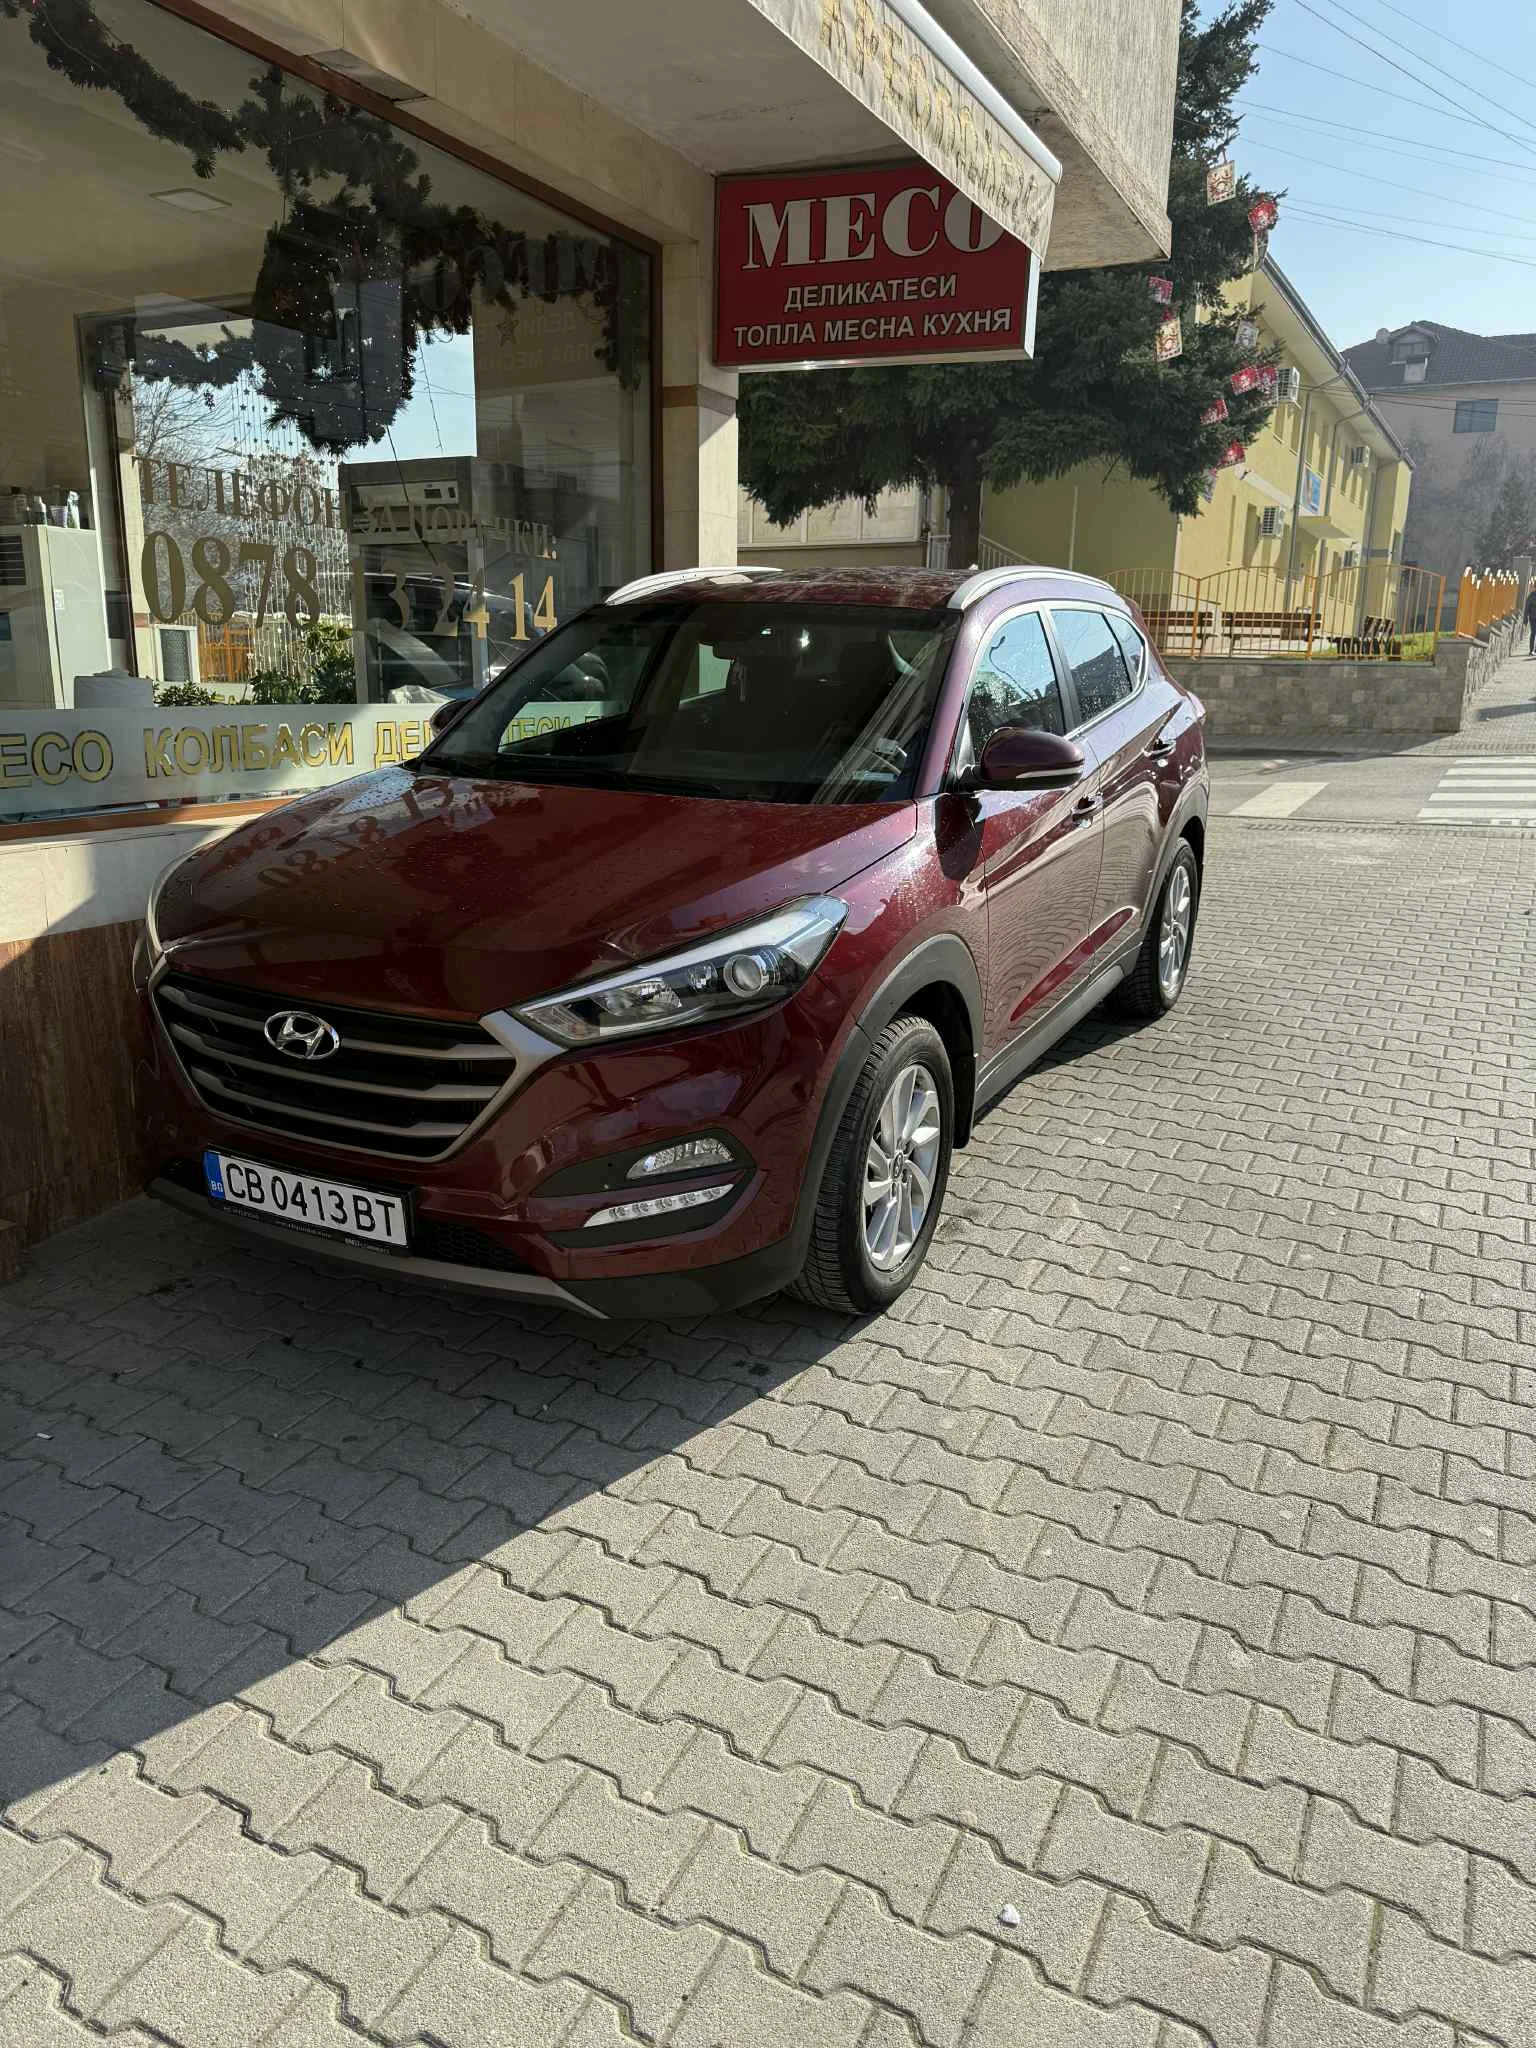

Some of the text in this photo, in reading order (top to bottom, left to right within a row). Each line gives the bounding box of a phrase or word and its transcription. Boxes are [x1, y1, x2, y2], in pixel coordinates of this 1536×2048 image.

[741, 186, 1005, 270] МЕСО
[784, 273, 957, 312] ДЕЛИКАТЕСИ
[733, 308, 1012, 349] ТОПЛА МЕСНА КУХНЯ
[132, 456, 349, 529] ТЕЛЕФОН
[142, 531, 321, 629] 0878
[143, 721, 355, 779] КОЛБАСИ
